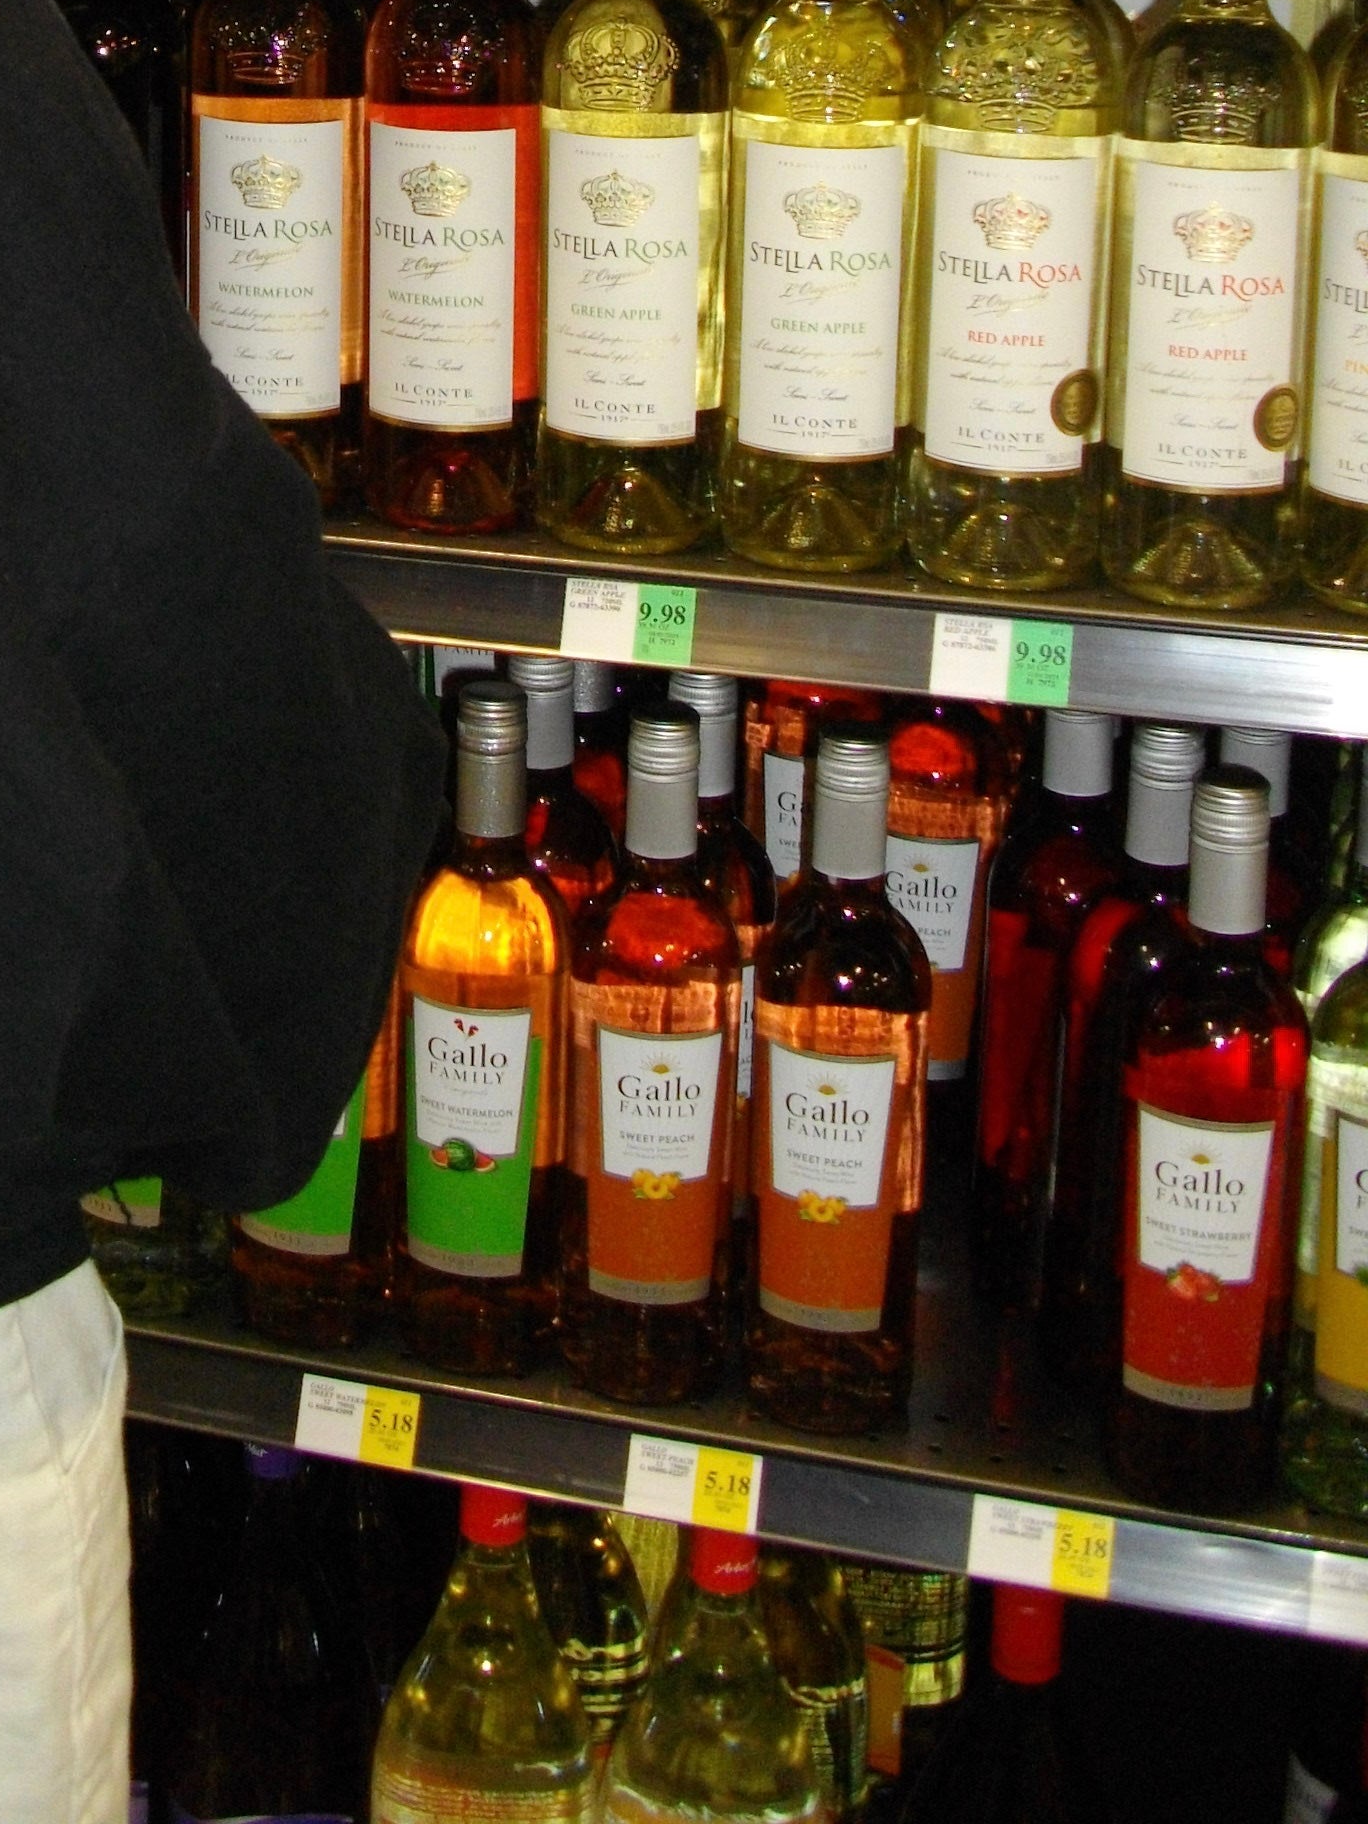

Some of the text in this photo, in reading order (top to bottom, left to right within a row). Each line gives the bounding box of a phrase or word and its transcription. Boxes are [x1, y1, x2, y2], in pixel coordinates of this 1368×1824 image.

[205, 211, 332, 245] STELLA ROSA
[375, 217, 504, 253] STELLA ROSA
[553, 229, 688, 265] STELLA ROSA
[750, 242, 892, 278] STELLA ROSA
[938, 251, 1082, 288] STELLA ROSA
[218, 282, 314, 298] WATERMELON
[1137, 264, 1285, 302] STELLA ROSA
[388, 289, 484, 308] WATERMELON
[570, 303, 662, 322] GREEN APPLE
[771, 317, 867, 336] GREEN APPLE
[968, 330, 1045, 348] RED APPLE
[1169, 344, 1247, 362] RED APPLE
[980, 428, 1045, 444] CONTE
[639, 603, 686, 625] 9.98
[1015, 641, 1066, 666] 9.98
[886, 871, 957, 900] Gallo
[428, 1037, 507, 1069] Gallo
[430, 1063, 505, 1086] FAMILY
[617, 1075, 701, 1101] Gallo
[447, 1105, 514, 1118] WATERMELON
[619, 1100, 698, 1118] FAMILY
[785, 1092, 870, 1126] Gallo
[619, 1131, 695, 1144] SWEET PEACH
[787, 1118, 866, 1143] FAMILY
[787, 1149, 863, 1169] SWEET PEACH
[1155, 1160, 1244, 1197] Gallo
[1156, 1188, 1239, 1215] FAMILY
[1146, 1216, 1252, 1242] SWEET STRAWBERRY
[369, 1408, 413, 1433] 5.18
[704, 1470, 751, 1496] 5.18
[1060, 1533, 1106, 1558] 5.18
